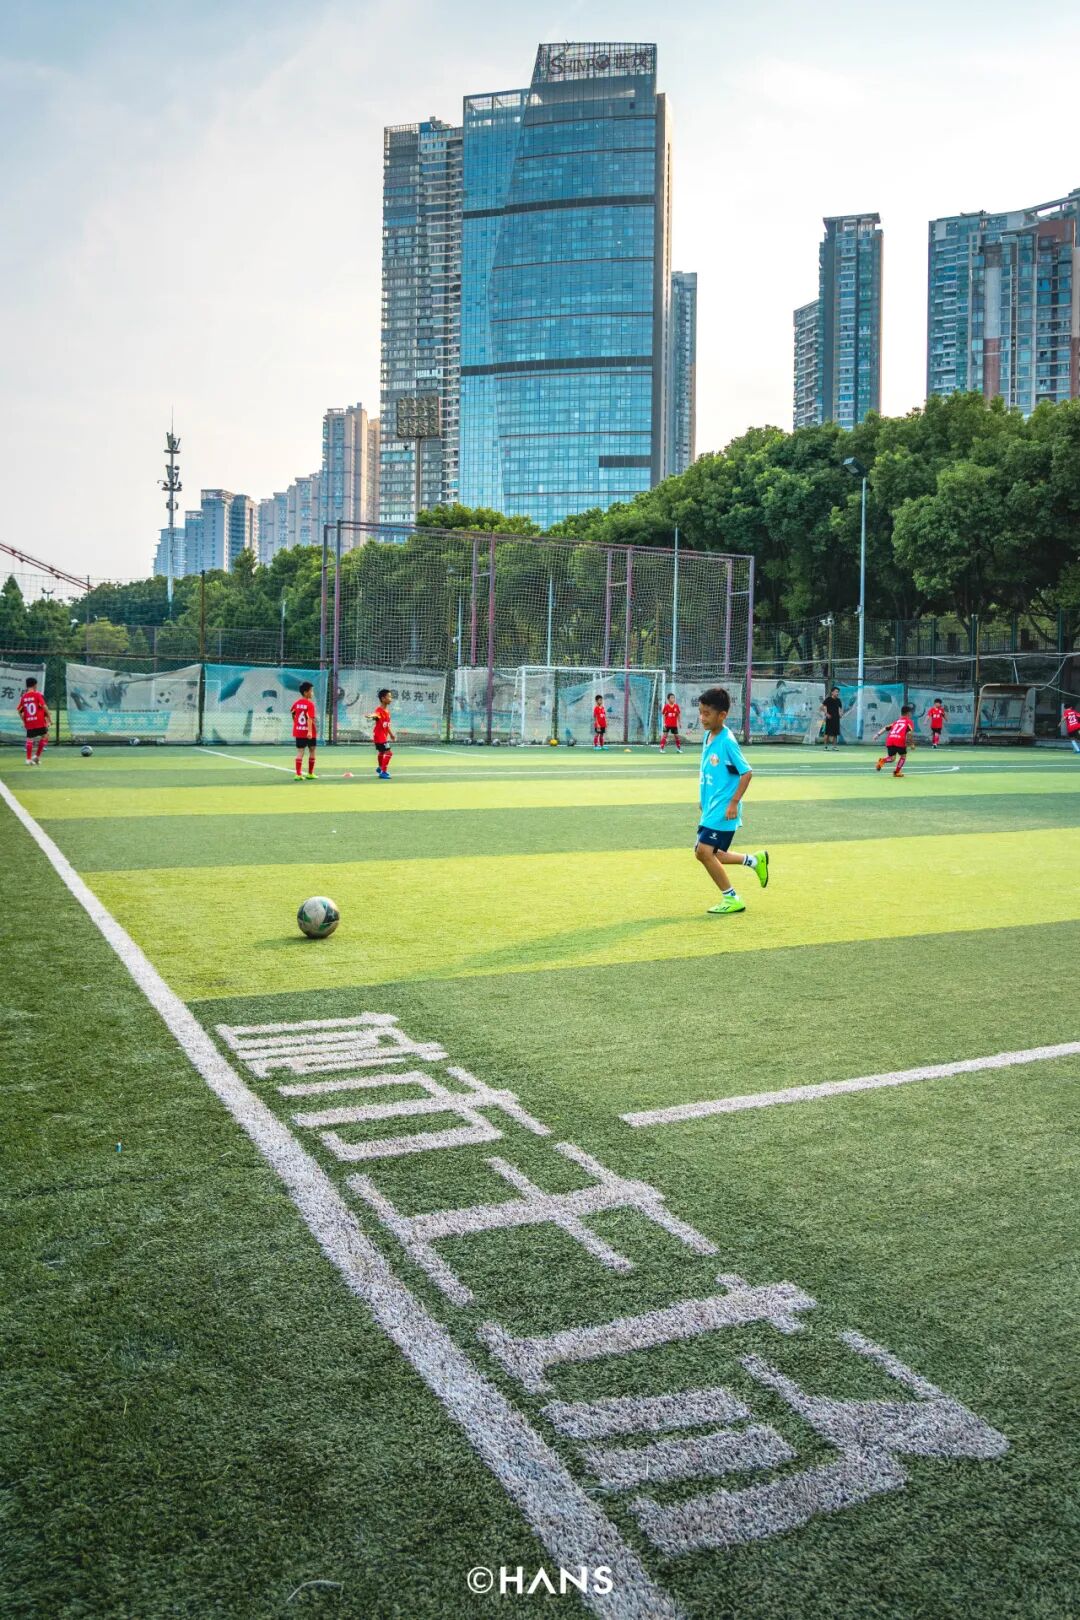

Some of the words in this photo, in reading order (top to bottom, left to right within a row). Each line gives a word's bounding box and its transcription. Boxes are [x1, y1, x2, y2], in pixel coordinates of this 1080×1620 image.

[298, 711, 306, 725] 6
[214, 1011, 1011, 1557] 城市主场
